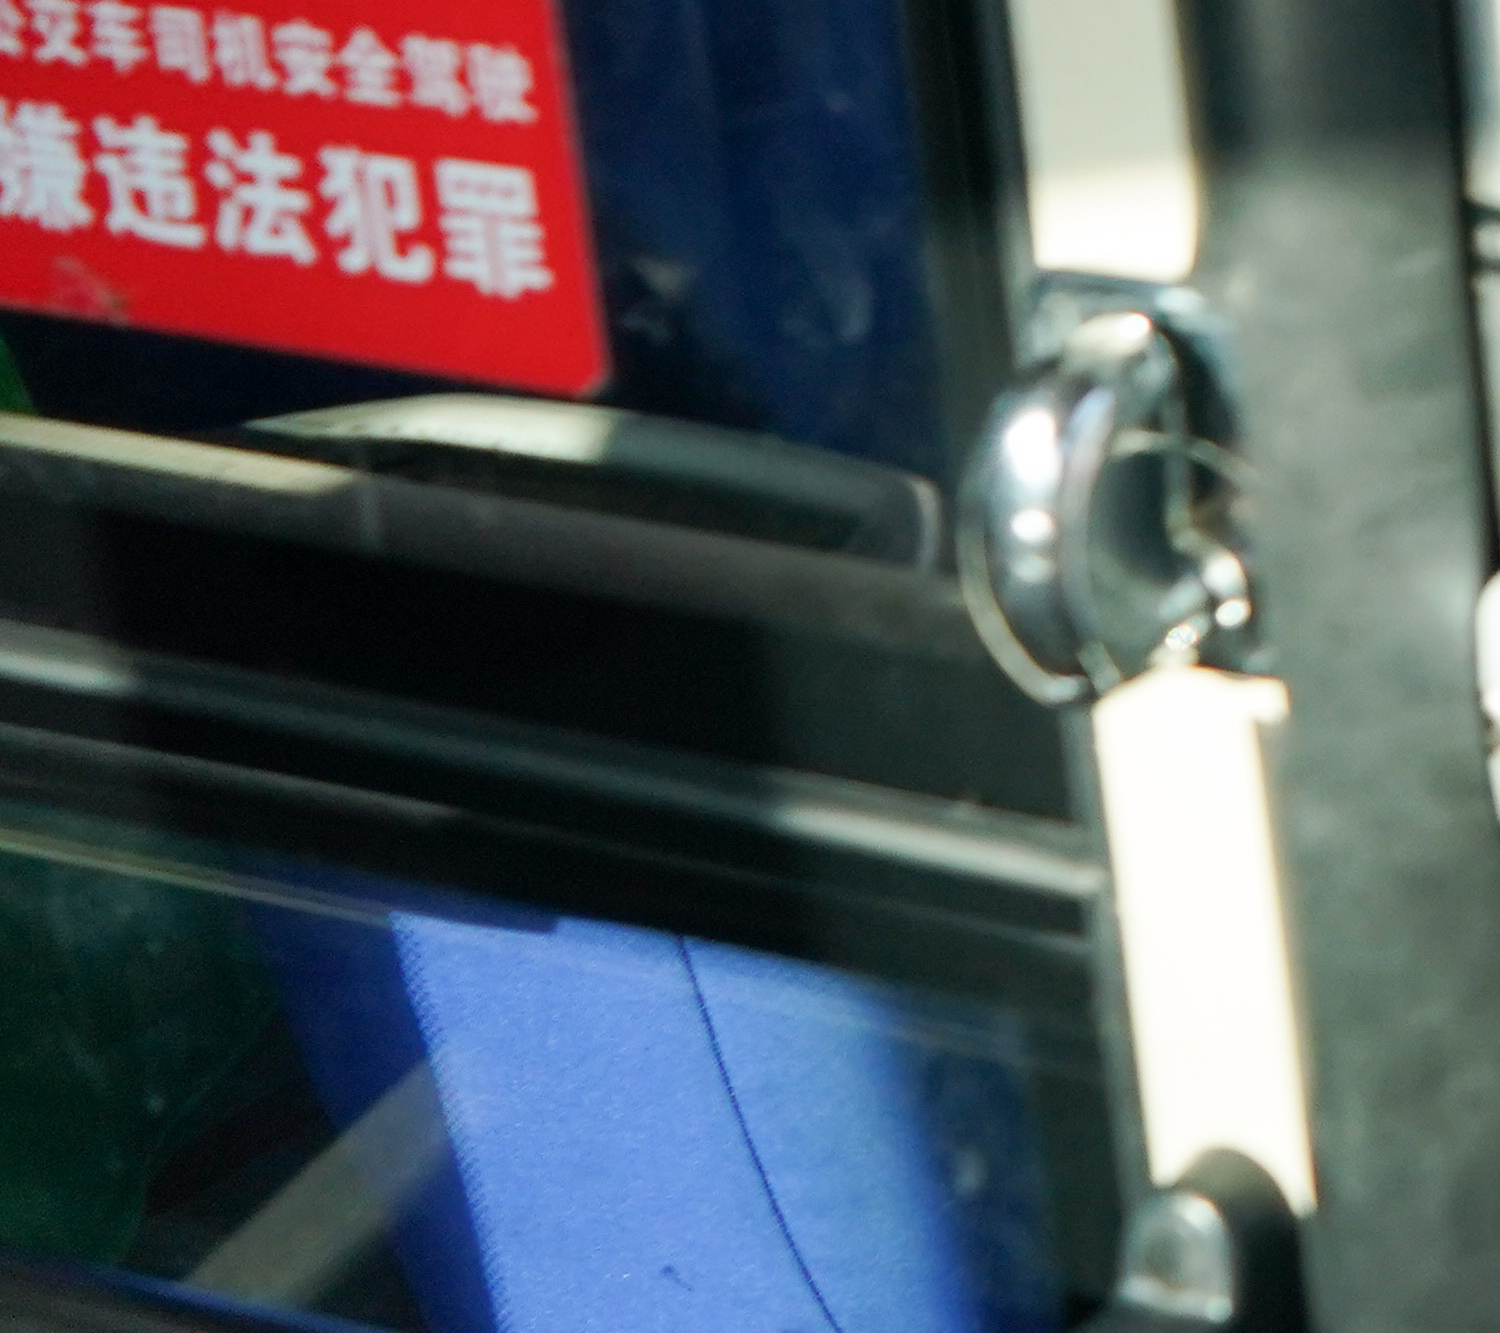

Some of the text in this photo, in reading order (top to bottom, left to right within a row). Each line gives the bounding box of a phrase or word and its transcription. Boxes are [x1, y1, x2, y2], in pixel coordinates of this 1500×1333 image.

[0, 96, 554, 300] 嫌违法犯罪
